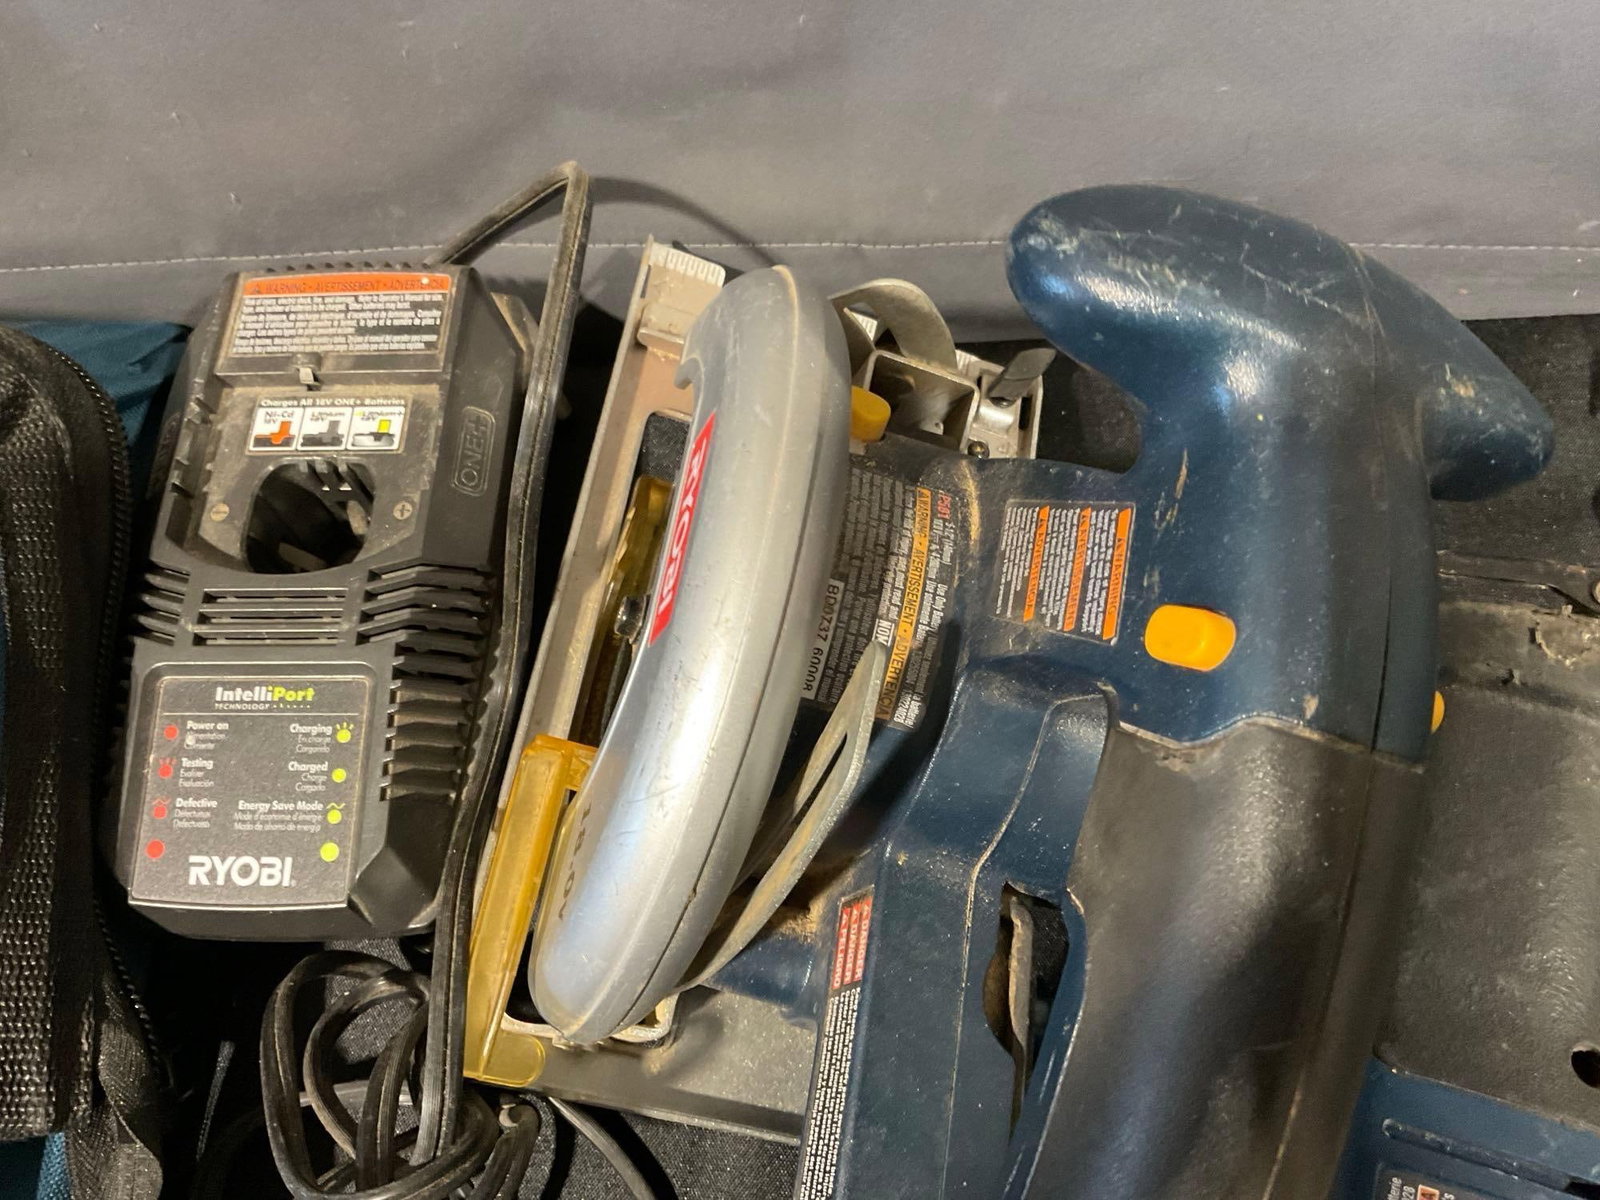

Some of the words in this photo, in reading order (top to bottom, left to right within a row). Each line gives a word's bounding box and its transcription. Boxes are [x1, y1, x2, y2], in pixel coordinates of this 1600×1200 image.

[364, 398, 405, 406] Batteries
[916, 498, 928, 538] WARNING
[938, 493, 951, 520] P501
[657, 437, 708, 616] RYOBI
[899, 548, 926, 626] AVERTISSEMENT
[816, 583, 839, 642] BD0737
[874, 619, 891, 645] NOM
[875, 634, 910, 717] ADVERTENCIA
[215, 686, 314, 701] IntelliPort
[186, 720, 215, 730] Power
[216, 722, 229, 730] on
[290, 723, 332, 735] Charging
[181, 758, 214, 769] Testing
[288, 761, 328, 773] Charged
[175, 797, 218, 808] Defective
[238, 800, 271, 812] Energy
[272, 800, 295, 810] Save
[296, 800, 324, 811] Mode
[188, 855, 293, 887] RYOBI
[833, 928, 848, 987] PELIGRO
[843, 923, 858, 982] DANGER
[854, 918, 869, 979] DANGER
